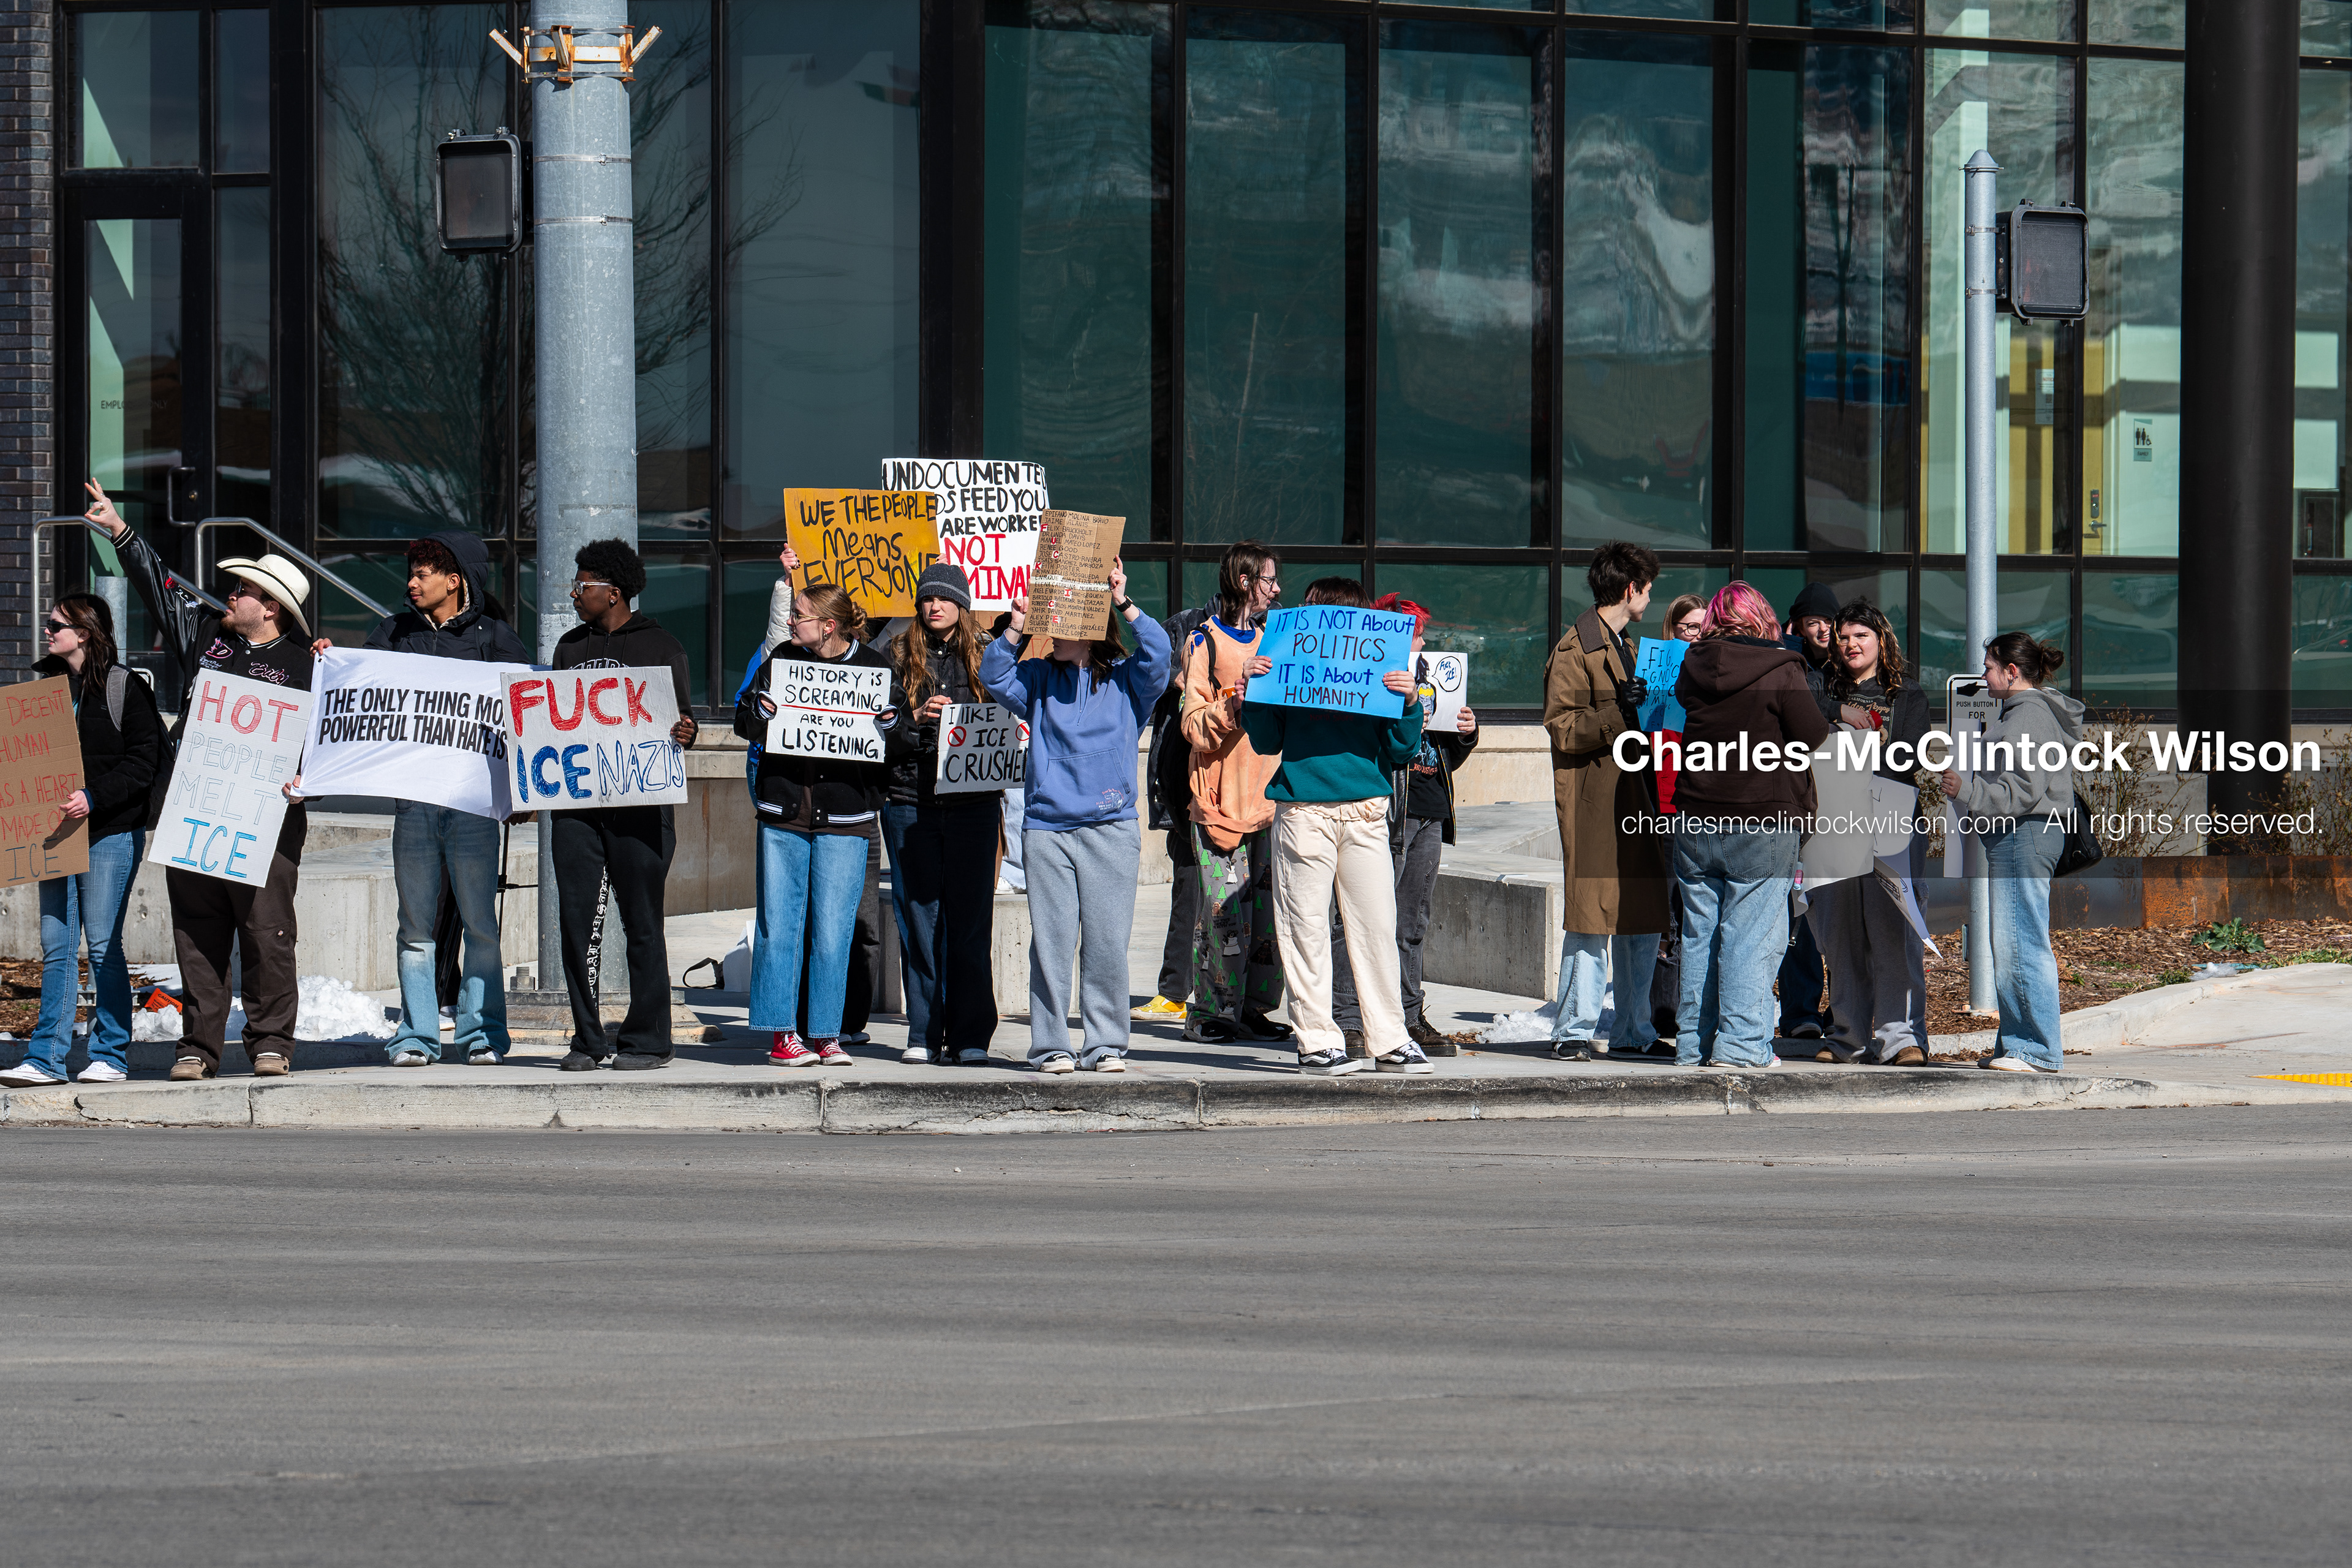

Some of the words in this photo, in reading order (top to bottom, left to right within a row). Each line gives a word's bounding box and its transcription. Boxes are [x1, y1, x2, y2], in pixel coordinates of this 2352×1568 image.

[800, 499, 835, 527] WE
[839, 493, 881, 525] THE
[882, 492, 937, 523] PEOPLE
[960, 487, 1008, 513] FEED
[940, 517, 976, 538] ARE
[978, 514, 1042, 533] WORKE
[1040, 524, 1060, 532] FELIX
[1068, 513, 1090, 521] MOLINA
[944, 533, 1006, 566] NOT
[1057, 564, 1080, 573] PORTER
[1069, 571, 1099, 580] MOSQUEDA
[1049, 600, 1066, 609] CARLOS
[1051, 627, 1070, 636] LOPEZ
[1275, 611, 1292, 633] IT
[1294, 609, 1310, 631] IS
[1318, 609, 1357, 630] NOT
[1292, 633, 1386, 662] POLITICS
[249, 662, 290, 685] Baby
[789, 665, 863, 690] HISTORY
[1278, 663, 1295, 684] IT
[1301, 665, 1315, 684] IS
[6, 689, 64, 726] DECENT
[197, 680, 299, 742] HOT
[325, 688, 358, 716] THE
[361, 688, 410, 712] ONLY
[413, 690, 471, 718] THING
[475, 694, 505, 727] MO
[509, 677, 652, 737] FUCK
[785, 684, 883, 712] SCREAMING
[1866, 702, 1891, 714] Poppy
[800, 714, 824, 726] ARE
[830, 716, 854, 728] YOU
[0, 731, 50, 763] HUMAN
[318, 715, 408, 745] POWERFUL
[412, 715, 456, 747] THAN
[456, 719, 491, 756] HATE
[782, 728, 879, 760] LISTENING
[972, 728, 1009, 748] ICE
[187, 731, 287, 784] PEOPLE
[517, 744, 592, 804] ICE
[597, 740, 684, 796] NAZIS
[21, 780, 29, 803] A
[35, 773, 78, 804] HEART
[173, 771, 277, 826] MELT
[1, 813, 44, 843] MADE
[5, 838, 62, 881] ICE
[172, 817, 257, 878] ICE
[157, 993, 179, 1009] CAUTION
